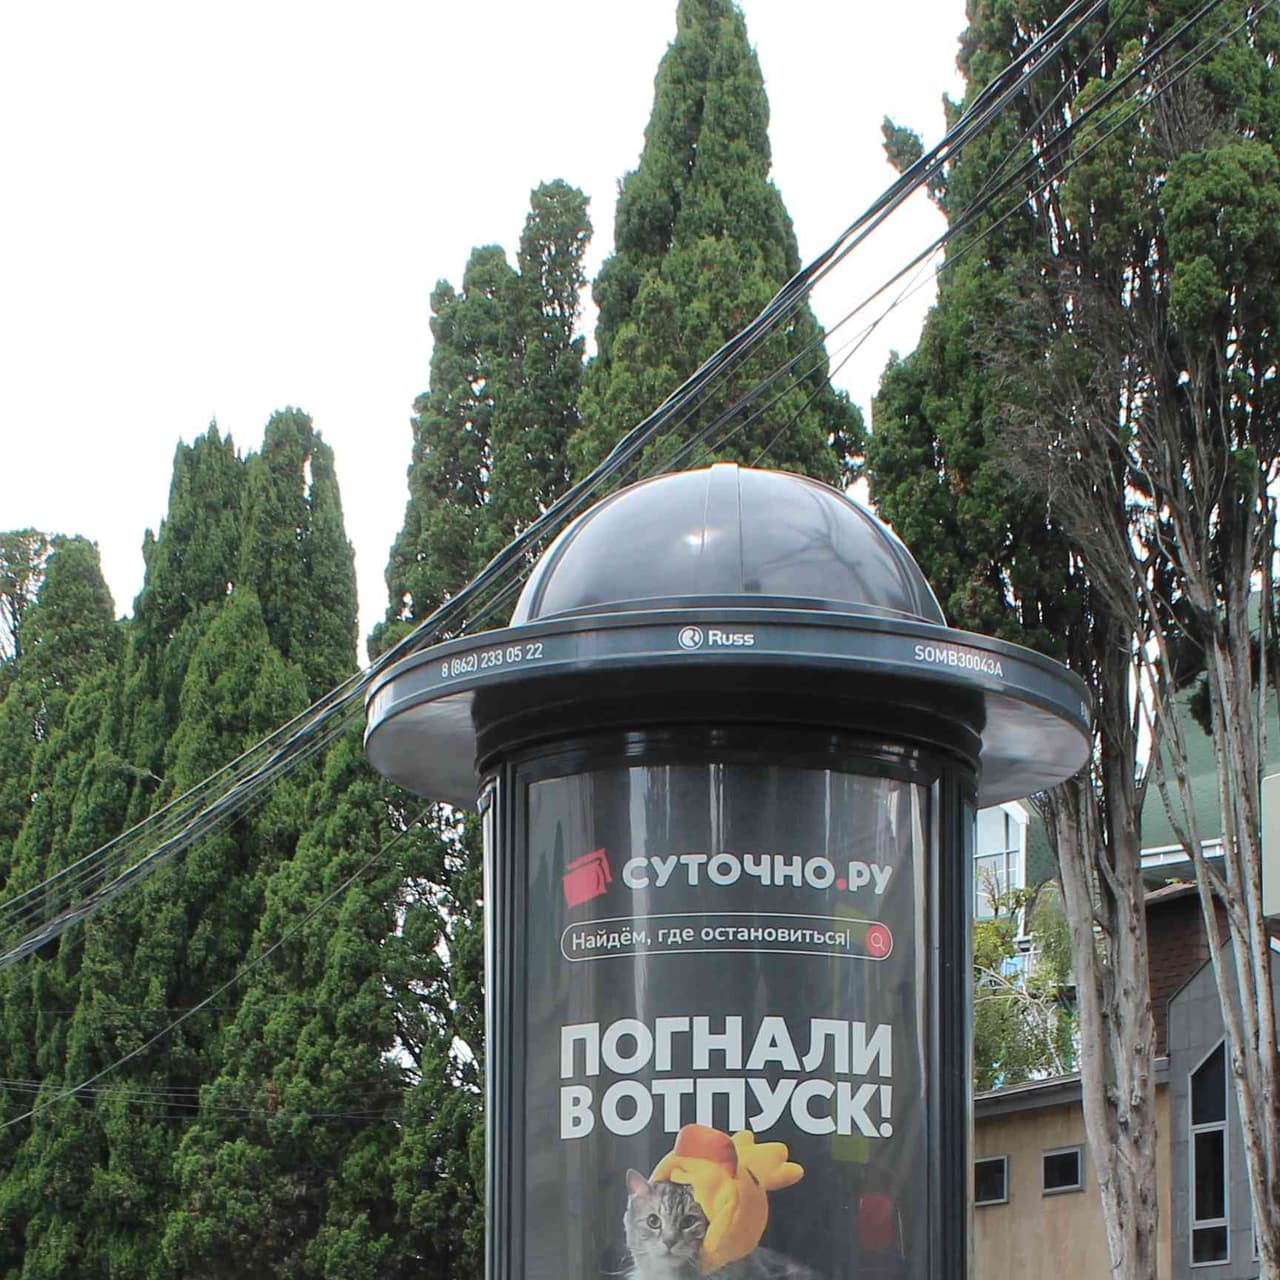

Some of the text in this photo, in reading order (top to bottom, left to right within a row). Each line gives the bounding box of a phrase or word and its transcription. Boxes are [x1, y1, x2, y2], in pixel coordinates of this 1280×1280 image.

[708, 630, 755, 646] Russ
[441, 643, 543, 678] 8 (862) 233 05 22
[914, 644, 1004, 678] SOMB30043A
[621, 852, 894, 895] СУТОЧНО.РУ
[571, 924, 846, 953] Найдём, где остановиться
[559, 1015, 894, 1079] ПОГНАЛИ
[559, 1078, 894, 1140] В ОТПУСК!
